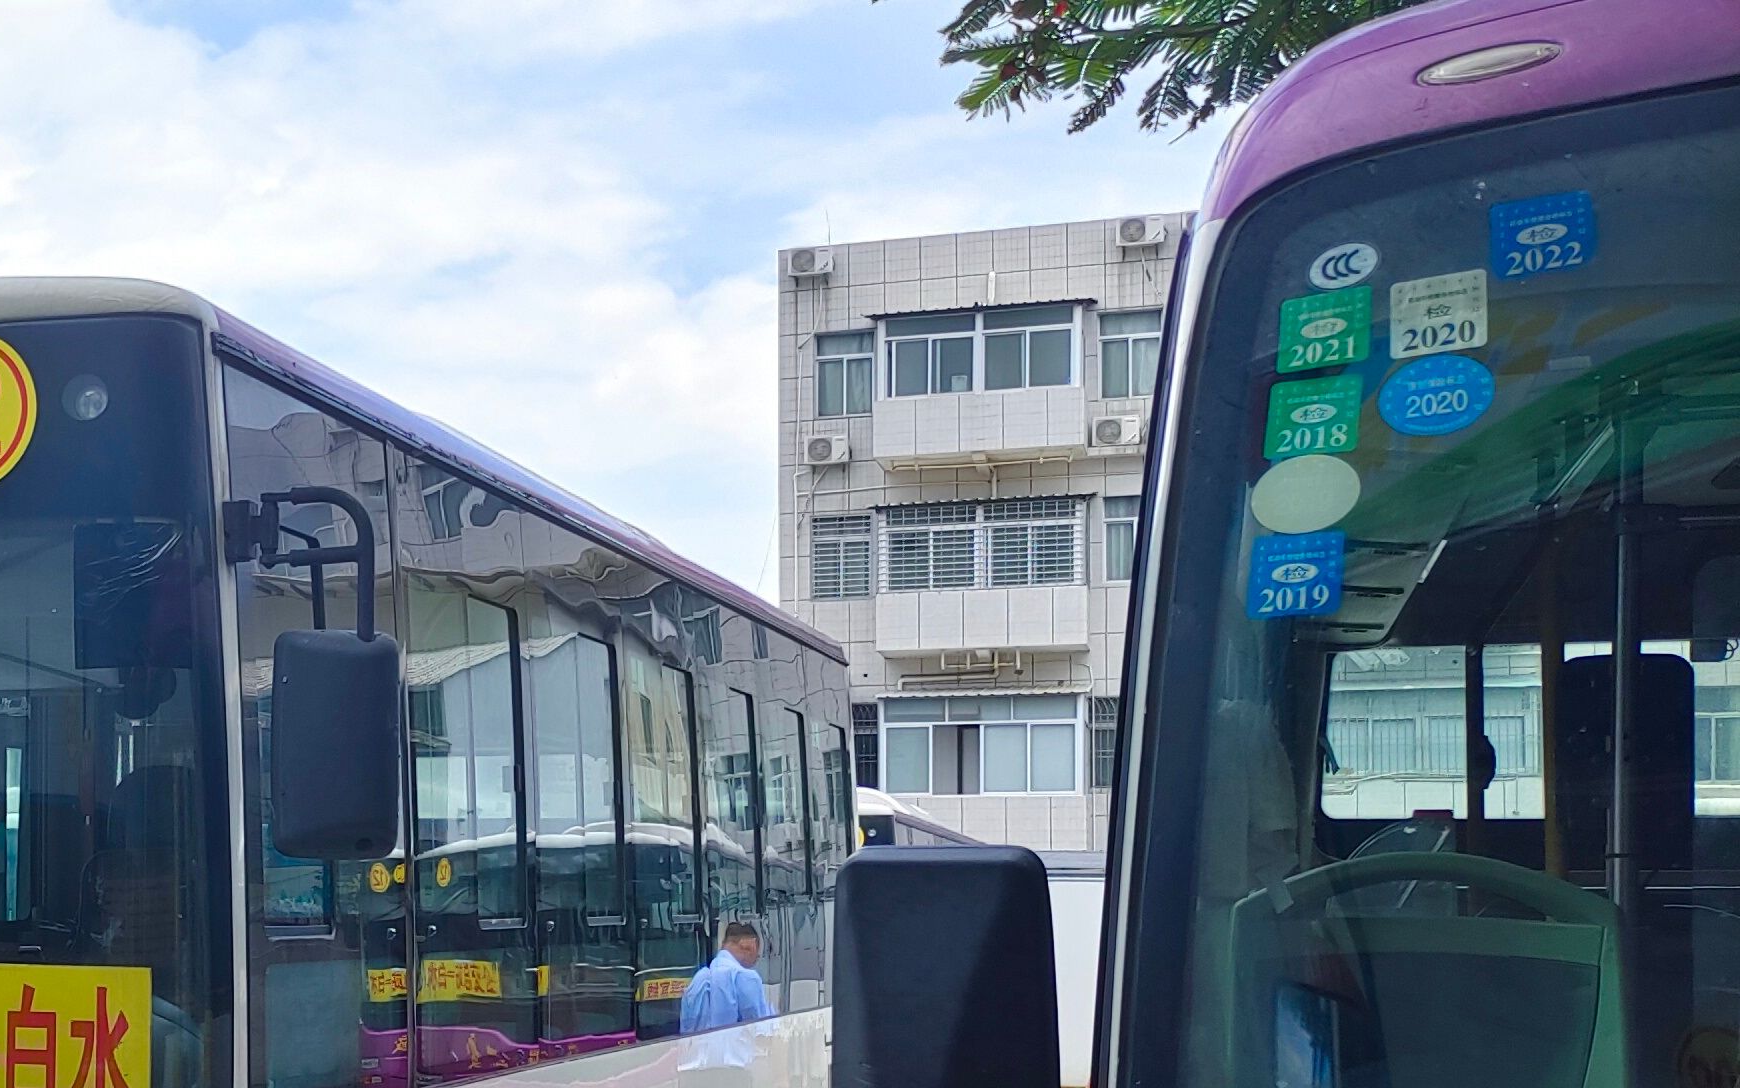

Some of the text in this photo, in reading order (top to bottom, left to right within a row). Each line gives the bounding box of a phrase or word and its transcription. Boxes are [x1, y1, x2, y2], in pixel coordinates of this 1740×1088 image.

[1322, 249, 1361, 280] CCC
[1505, 242, 1583, 276] 2022
[1288, 335, 1355, 368] 2021
[1402, 320, 1476, 352] 2020
[1404, 389, 1469, 420] 2020
[1275, 423, 1349, 453] 2018
[1258, 584, 1330, 614] 2019
